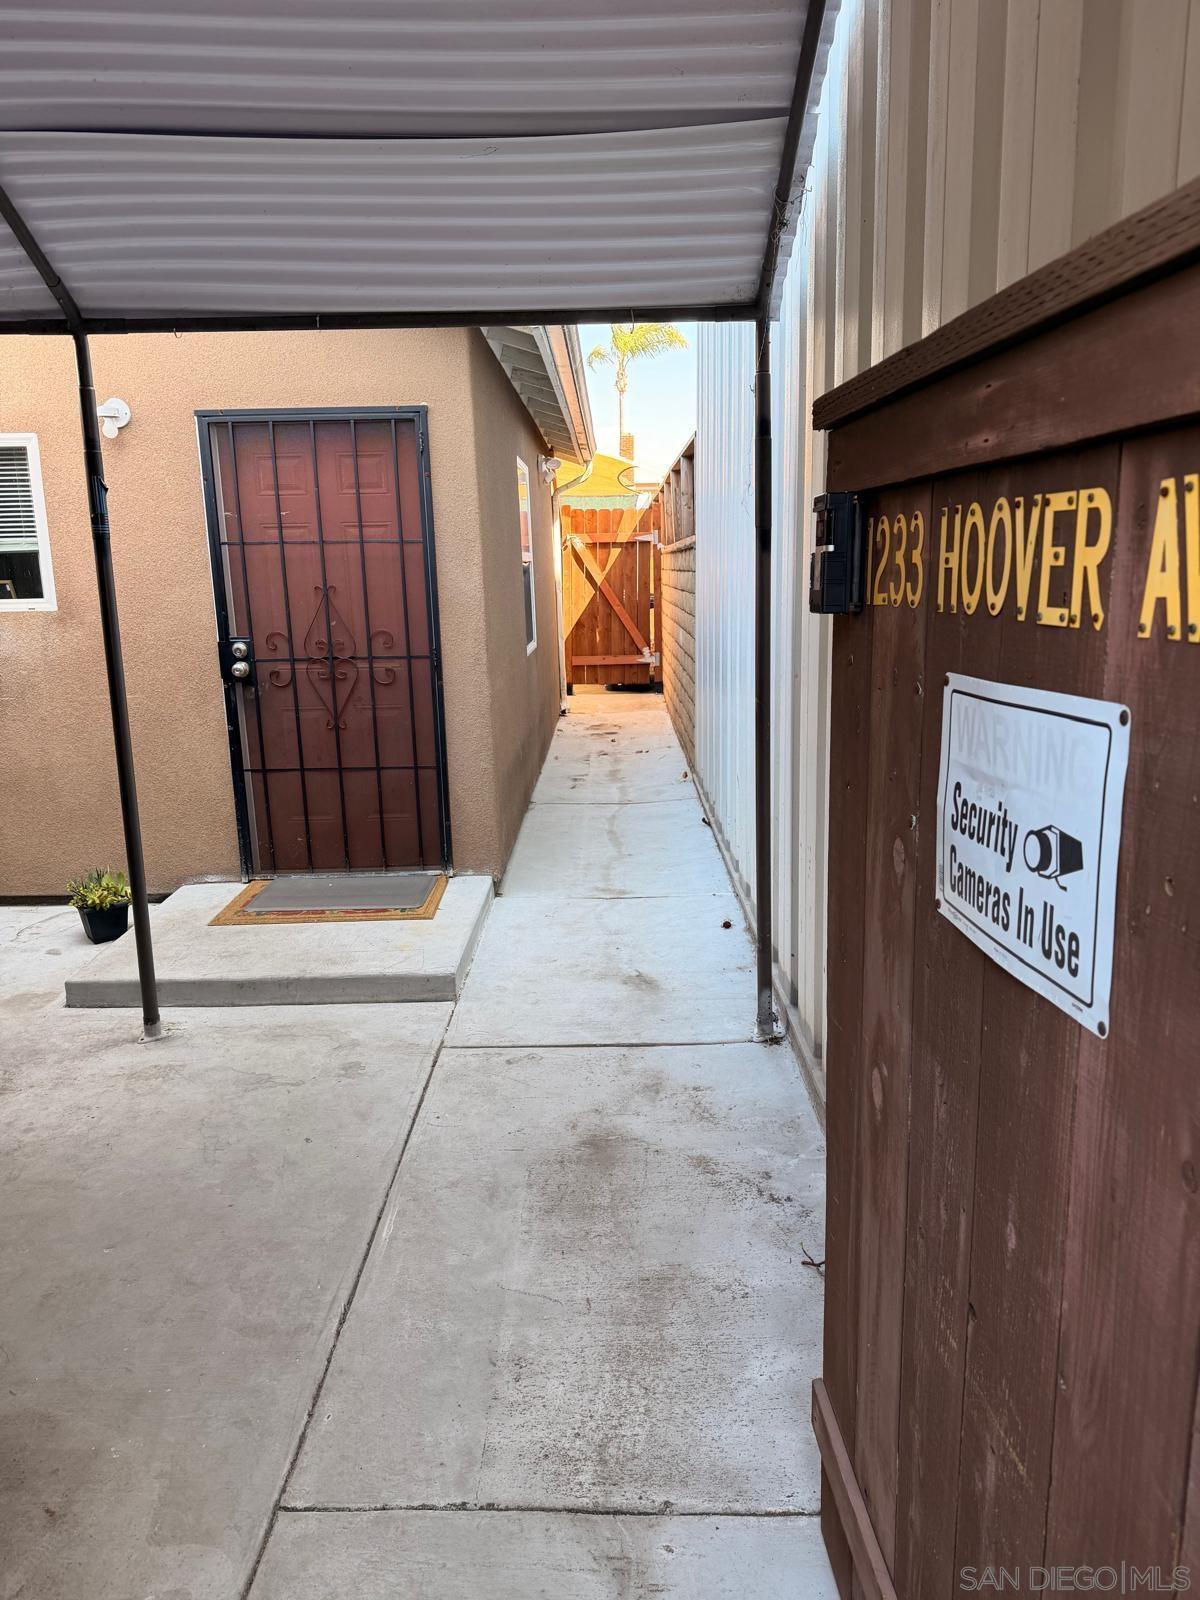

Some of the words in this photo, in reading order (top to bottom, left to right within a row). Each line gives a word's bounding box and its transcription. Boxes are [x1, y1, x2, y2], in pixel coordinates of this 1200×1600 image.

[866, 510, 925, 608] 1233
[937, 487, 1113, 631] HOOVER
[951, 781, 1018, 873] Security
[950, 844, 1011, 932] Cameras
[1016, 886, 1034, 948] In
[1040, 900, 1081, 978] Use
